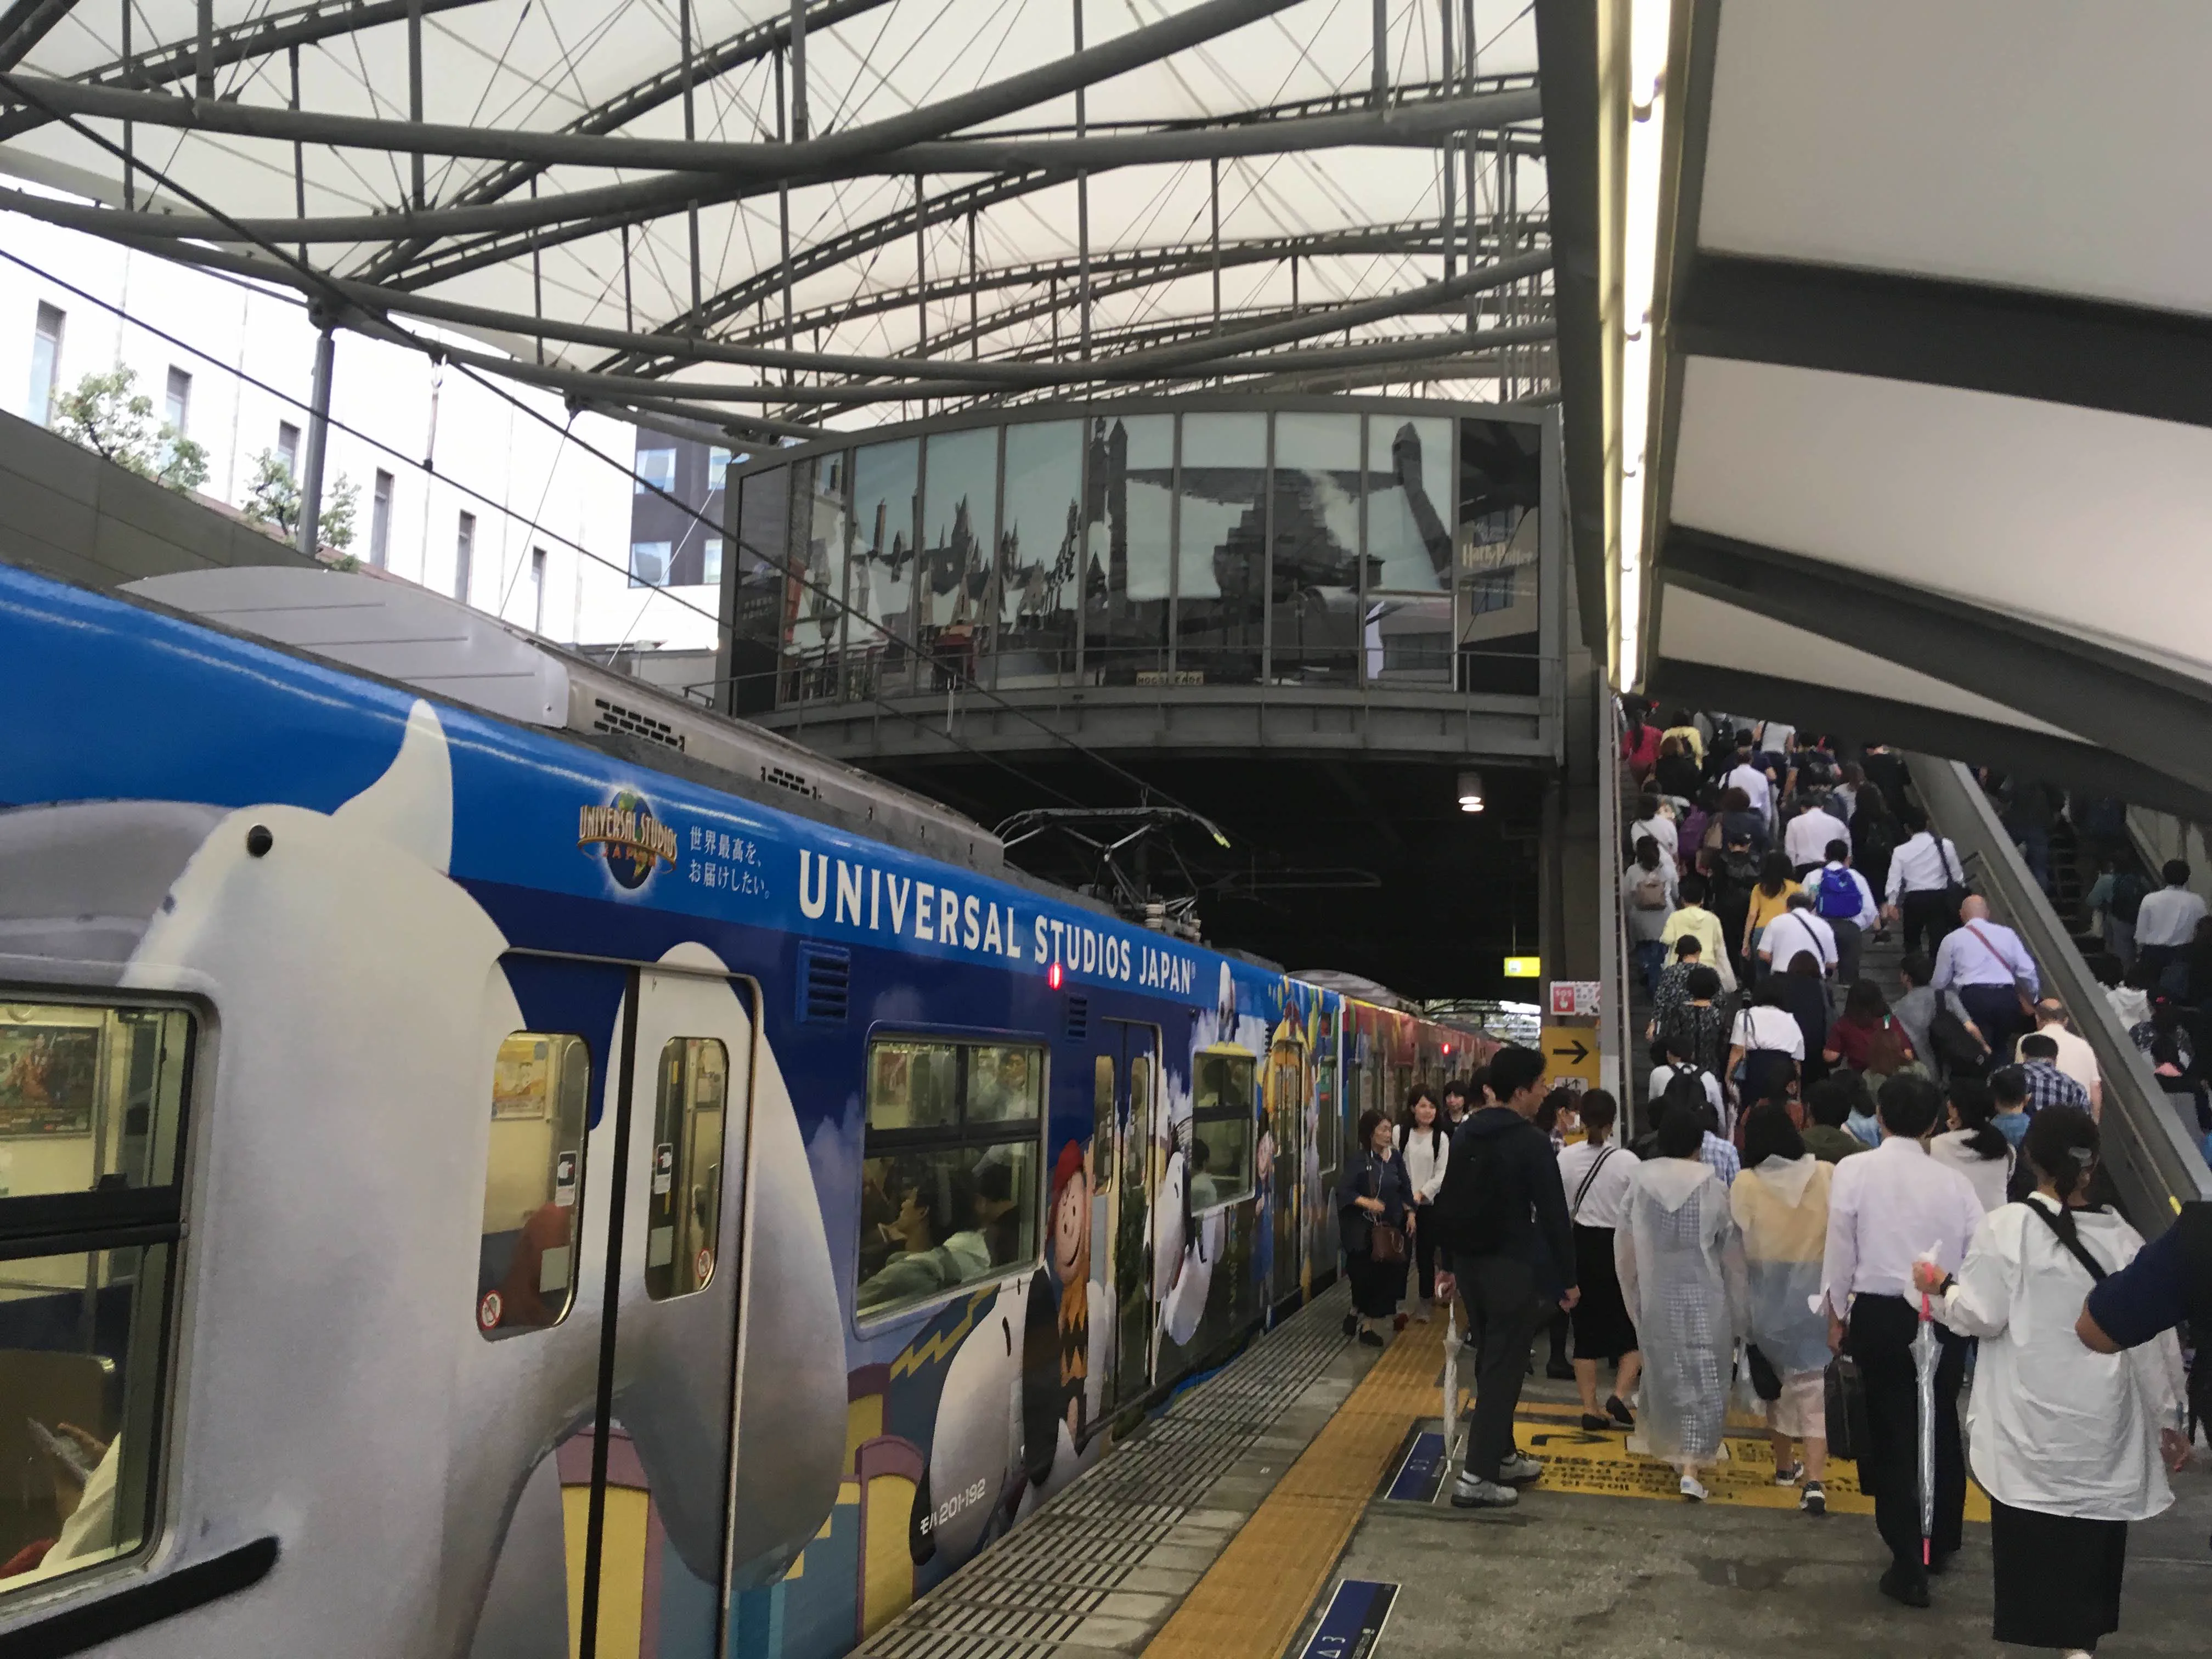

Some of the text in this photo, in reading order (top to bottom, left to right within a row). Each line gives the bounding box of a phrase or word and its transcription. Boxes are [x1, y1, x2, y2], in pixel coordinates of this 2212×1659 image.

[579, 805, 678, 861] UNIVERSAL STUDIOS
[690, 825, 762, 868] 世界最高を、
[689, 858, 771, 900] お届けしたい。
[798, 848, 1022, 959] UNIVERSAL
[1034, 915, 1131, 982] STUDIOS
